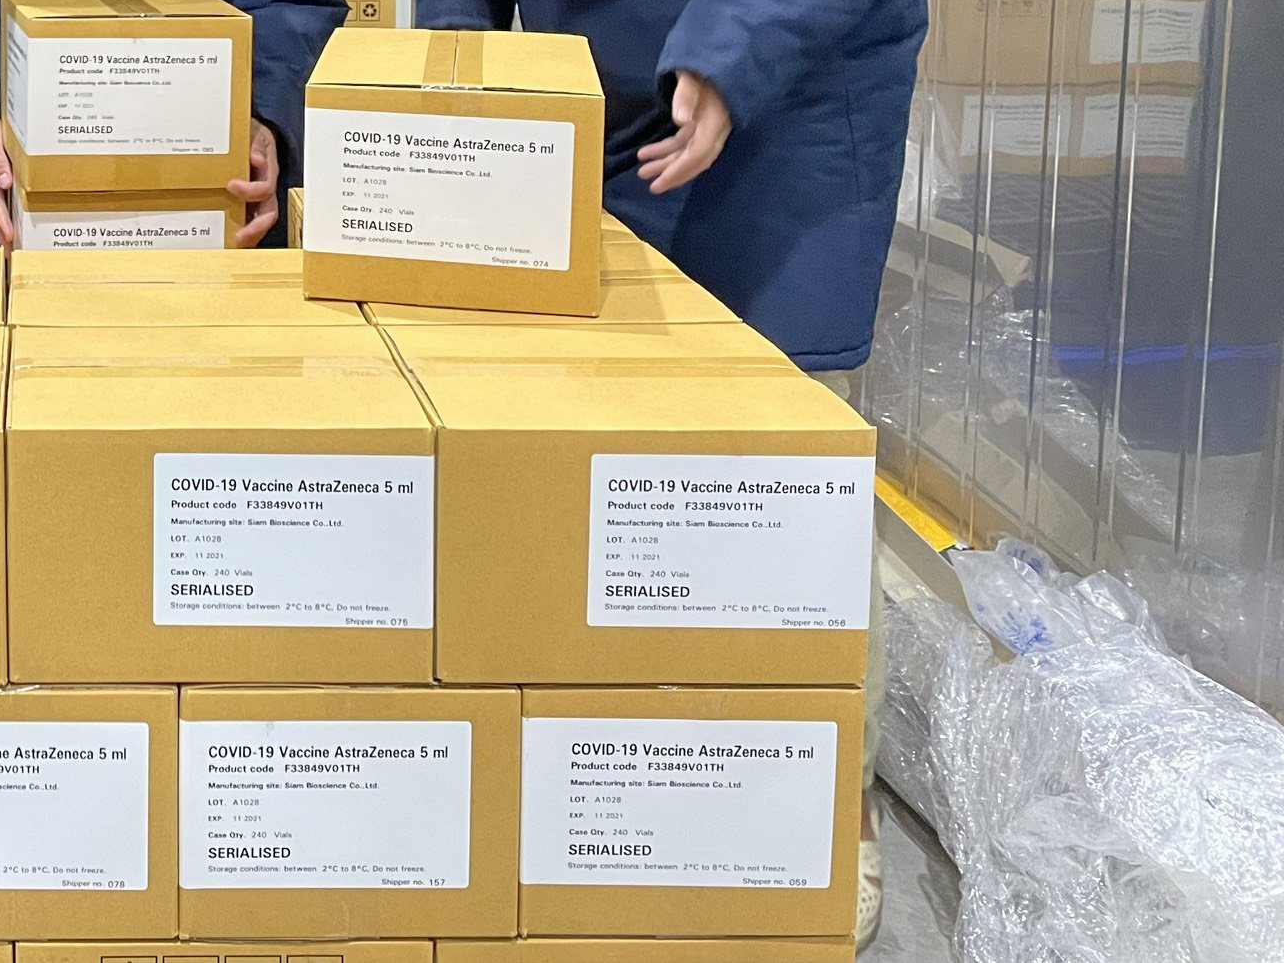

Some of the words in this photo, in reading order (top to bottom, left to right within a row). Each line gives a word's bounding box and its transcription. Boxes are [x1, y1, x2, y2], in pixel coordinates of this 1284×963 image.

[60, 55, 103, 64] COVID-19
[106, 56, 140, 64] Vaccine
[143, 56, 196, 64] AstraZeneca
[199, 56, 204, 64] 5
[58, 126, 113, 134] SERIALISED
[344, 131, 401, 145] COVID-19
[405, 135, 449, 148] Vaccine
[453, 137, 524, 152] AstraZeneca
[529, 142, 536, 153] 5
[541, 142, 554, 154] ml
[344, 148, 376, 157] Product
[380, 150, 400, 158] code
[409, 151, 475, 162] F33849V01TH
[342, 219, 413, 233] SERIALISED
[54, 228, 97, 237] COVID-19
[100, 228, 133, 236] Vaccine
[136, 228, 188, 236] AstraZeneca
[192, 227, 197, 236] 5
[200, 227, 210, 235] ml
[492, 256, 517, 265] Shipper
[172, 479, 236, 491] COVID-19
[242, 479, 293, 492] Vaccine
[298, 480, 379, 493] AstraZeneca
[385, 481, 392, 493] 5
[398, 481, 413, 493] ml
[609, 479, 675, 492] COVID-19
[681, 480, 732, 493] Vaccine
[737, 481, 820, 494] AstraZeneca
[826, 482, 834, 494] 5
[840, 482, 854, 494] ml
[171, 500, 209, 508] Product
[213, 501, 236, 509] code
[247, 501, 323, 510] F33849V01TH
[608, 501, 646, 510] Product
[650, 502, 674, 510] code
[685, 502, 762, 511] F33849V01TH
[171, 584, 253, 596] SERIALISED
[606, 585, 690, 597] SERIALISED
[781, 618, 811, 626] Shipper
[14, 747, 93, 759] AstraZeneca
[99, 748, 106, 760] 5
[112, 748, 126, 760] ml
[209, 746, 274, 758] COVID-19
[279, 746, 329, 758] Vaccine
[335, 746, 414, 758] AstraZeneca
[421, 746, 428, 758] 5
[433, 746, 448, 758] ml
[572, 743, 637, 756] COVID-19
[643, 744, 693, 756] Vaccine
[699, 745, 779, 758] AstraZeneca
[785, 746, 793, 758] 5
[799, 747, 813, 758] ml
[209, 765, 246, 773] Product
[250, 765, 274, 773] code
[285, 764, 360, 772] F33849V01TH
[571, 762, 609, 770] Product
[613, 762, 637, 770] code
[648, 763, 724, 771] F33849V01TH
[208, 847, 290, 858] SERIALISED
[569, 844, 651, 856] SERIALISED
[62, 880, 90, 888] Shipper
[742, 877, 771, 885] Shipper
